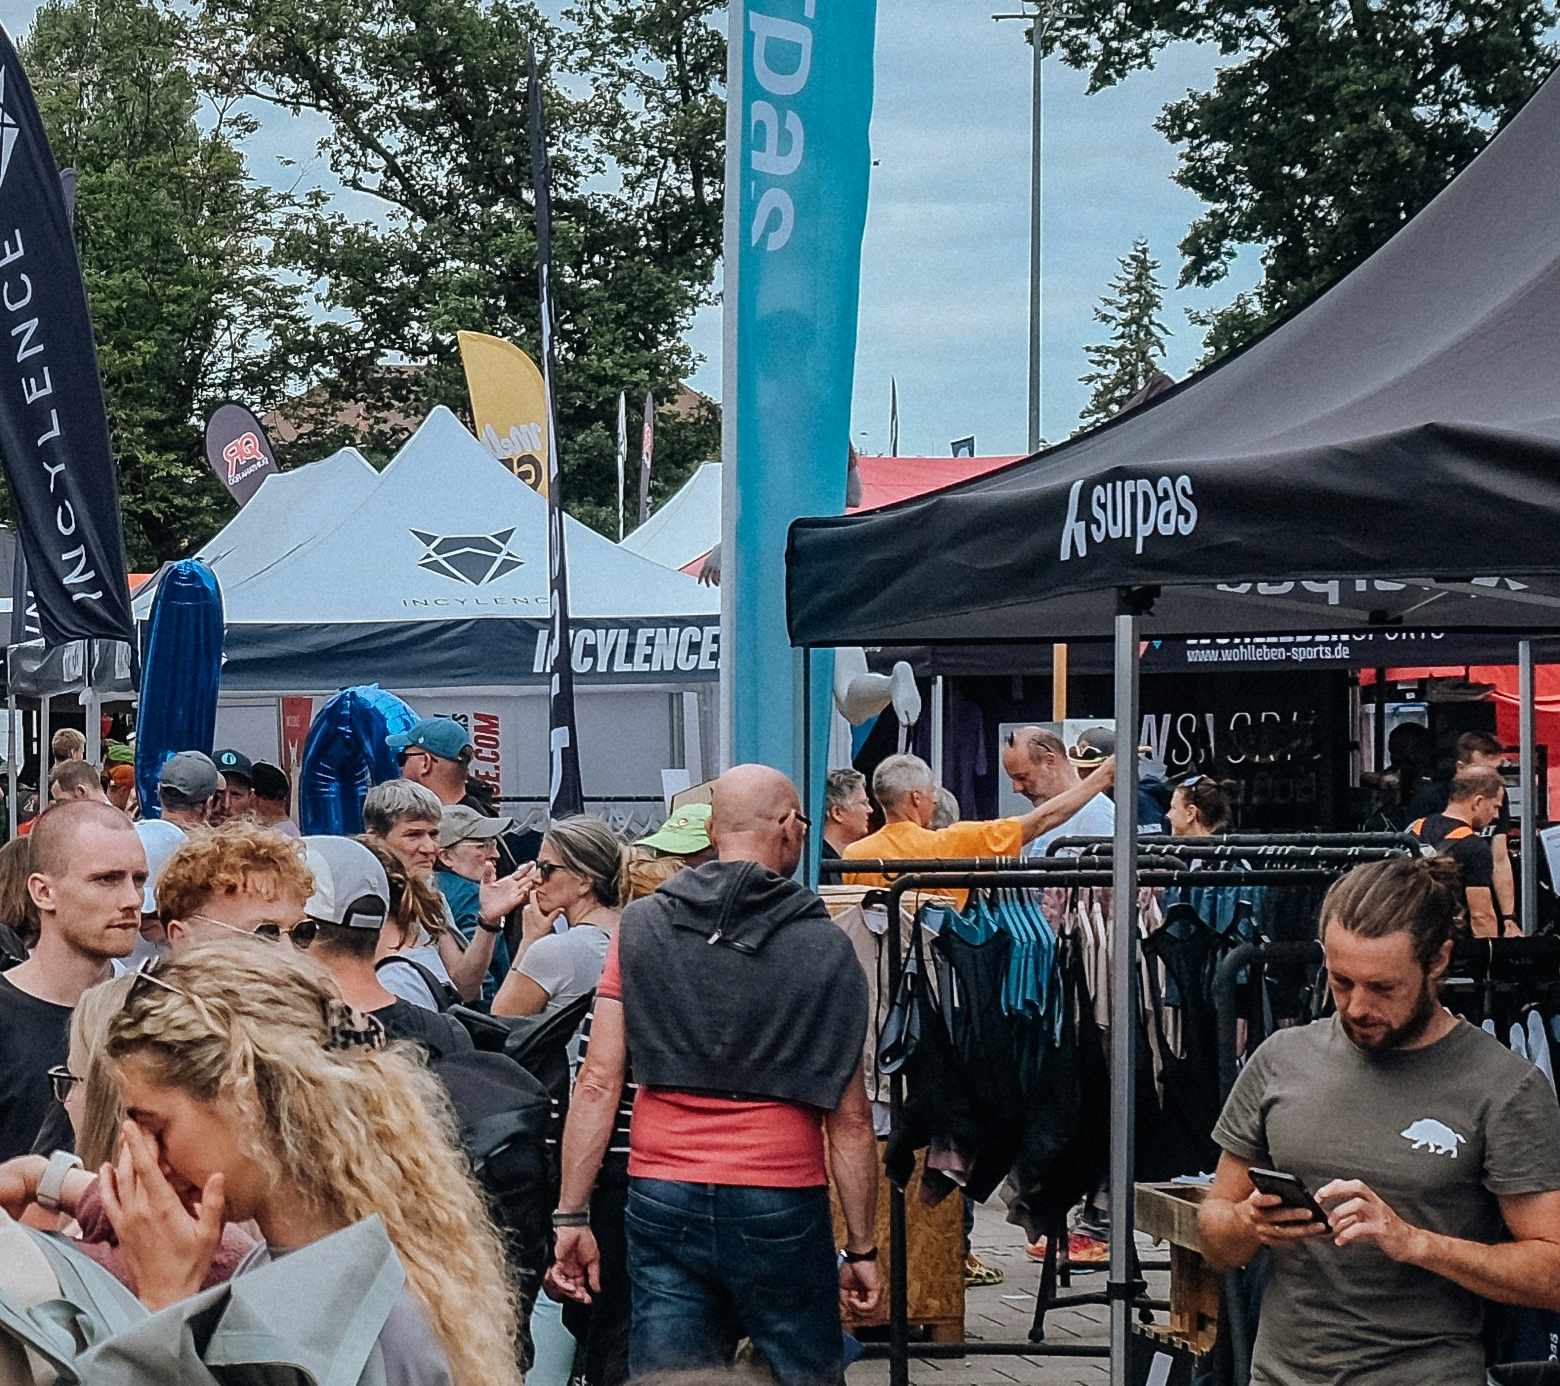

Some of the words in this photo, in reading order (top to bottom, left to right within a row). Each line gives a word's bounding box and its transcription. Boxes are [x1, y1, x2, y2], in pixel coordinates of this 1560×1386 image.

[1090, 473, 1199, 554] surpas
[402, 596, 550, 607] INCYLENC
[1186, 642, 1351, 663] www.wohlleben-sports.de
